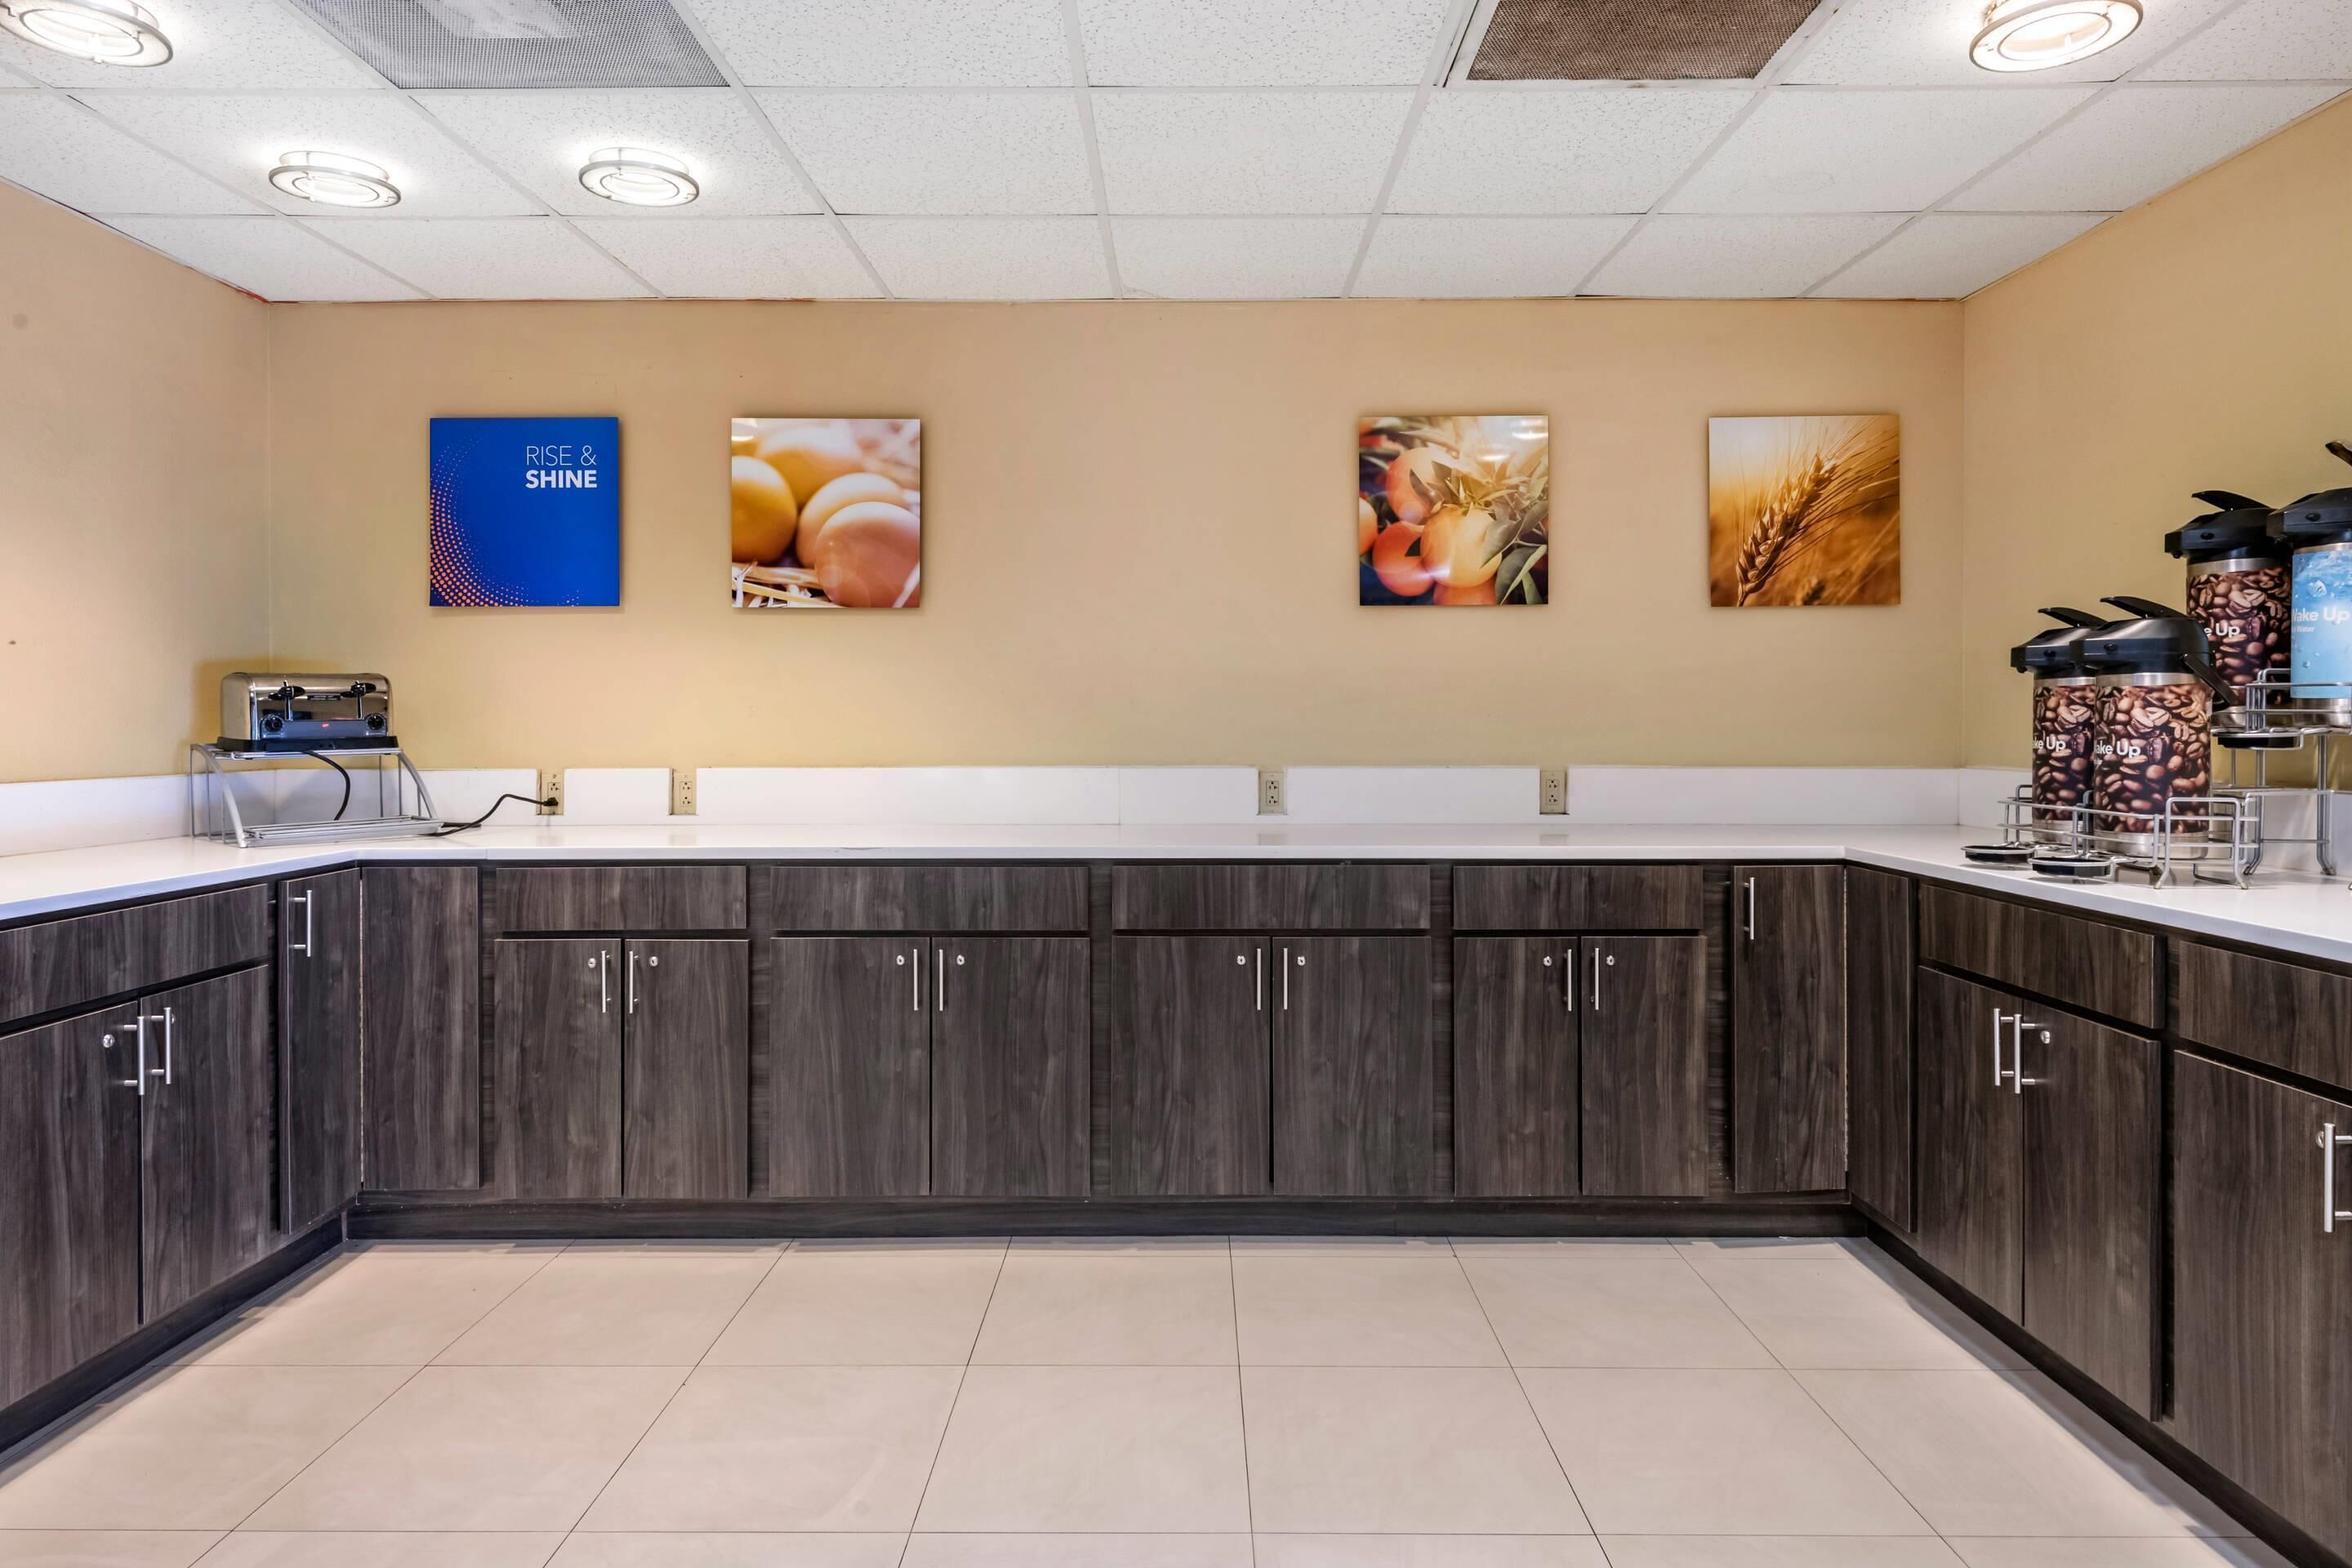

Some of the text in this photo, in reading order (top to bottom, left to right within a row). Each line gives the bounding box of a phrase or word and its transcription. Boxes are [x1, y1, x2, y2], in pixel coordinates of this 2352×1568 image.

[527, 445, 597, 466] RISE &
[525, 470, 598, 488] SHINE
[2323, 607, 2351, 625] Up
[2216, 622, 2241, 638] Up
[2046, 736, 2066, 753] Up
[2116, 741, 2141, 759] Up
